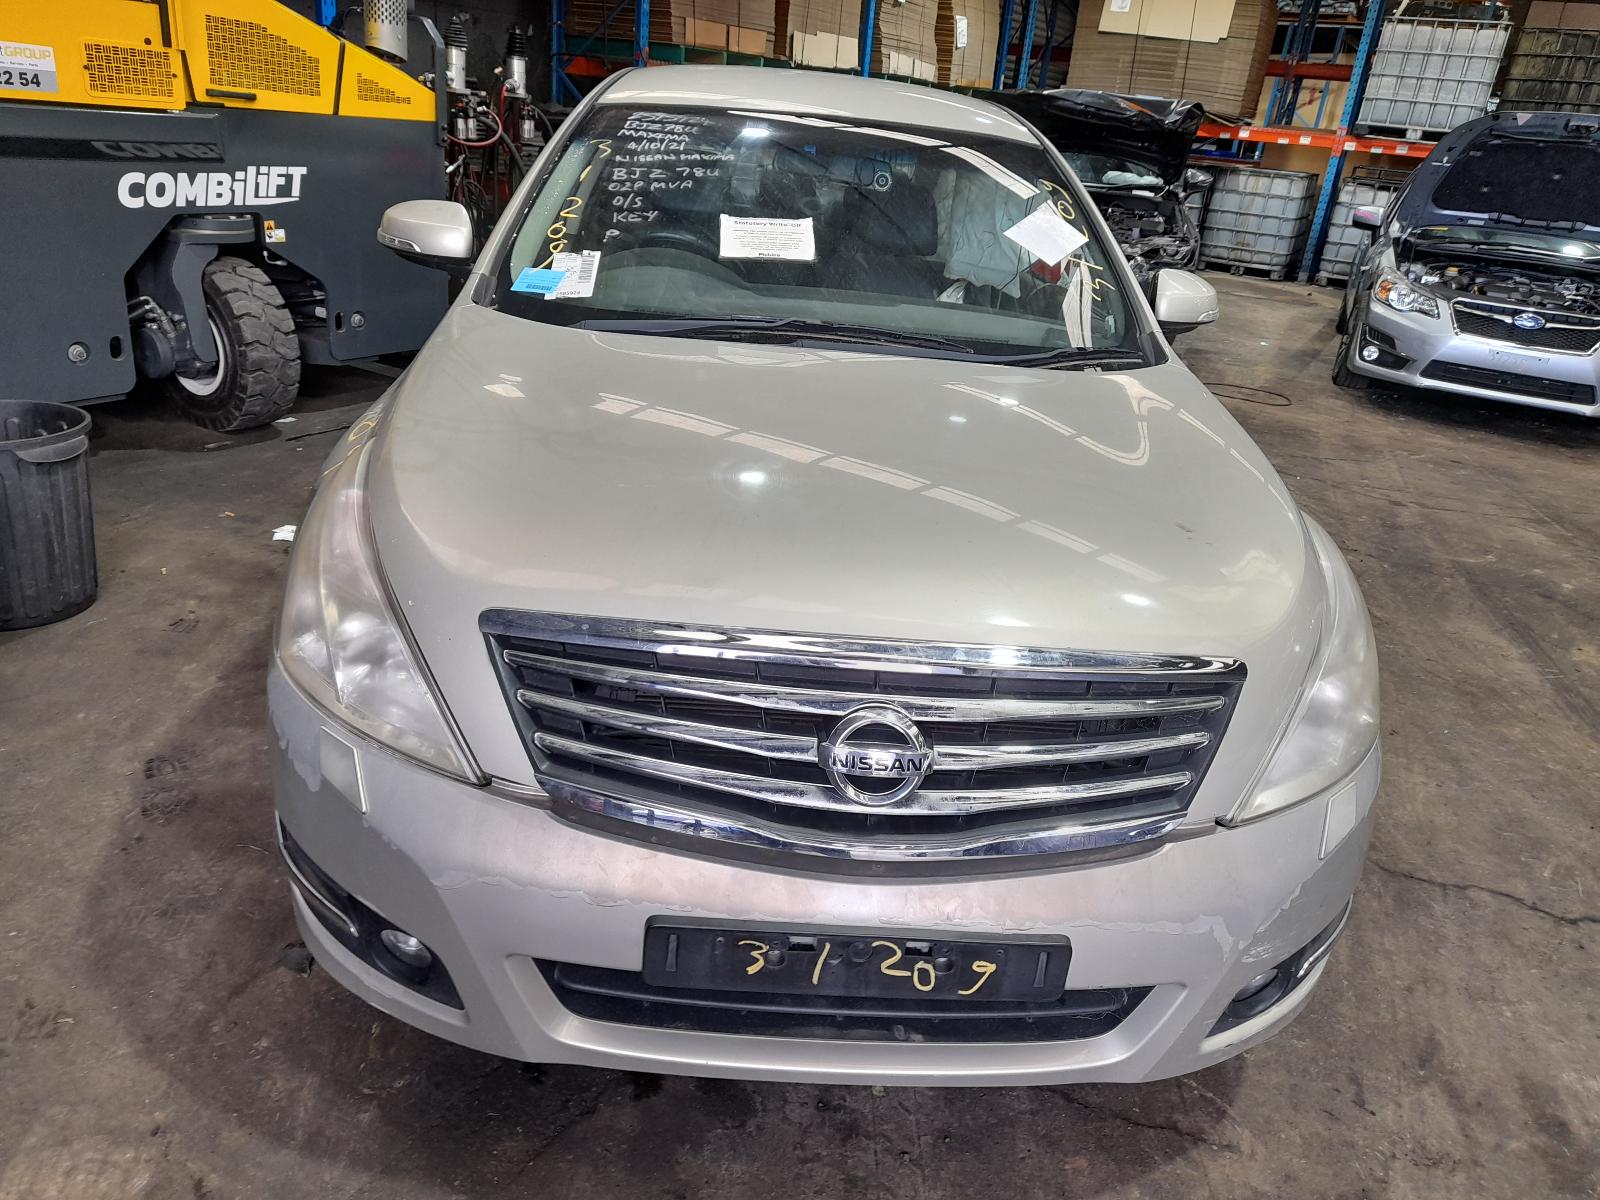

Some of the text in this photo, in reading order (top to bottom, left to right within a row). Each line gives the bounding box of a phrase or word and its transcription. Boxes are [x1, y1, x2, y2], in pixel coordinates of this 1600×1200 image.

[18, 71, 42, 88] 54
[650, 179, 694, 193] MVA
[613, 210, 659, 223] KEY
[831, 751, 923, 773] NISSAN
